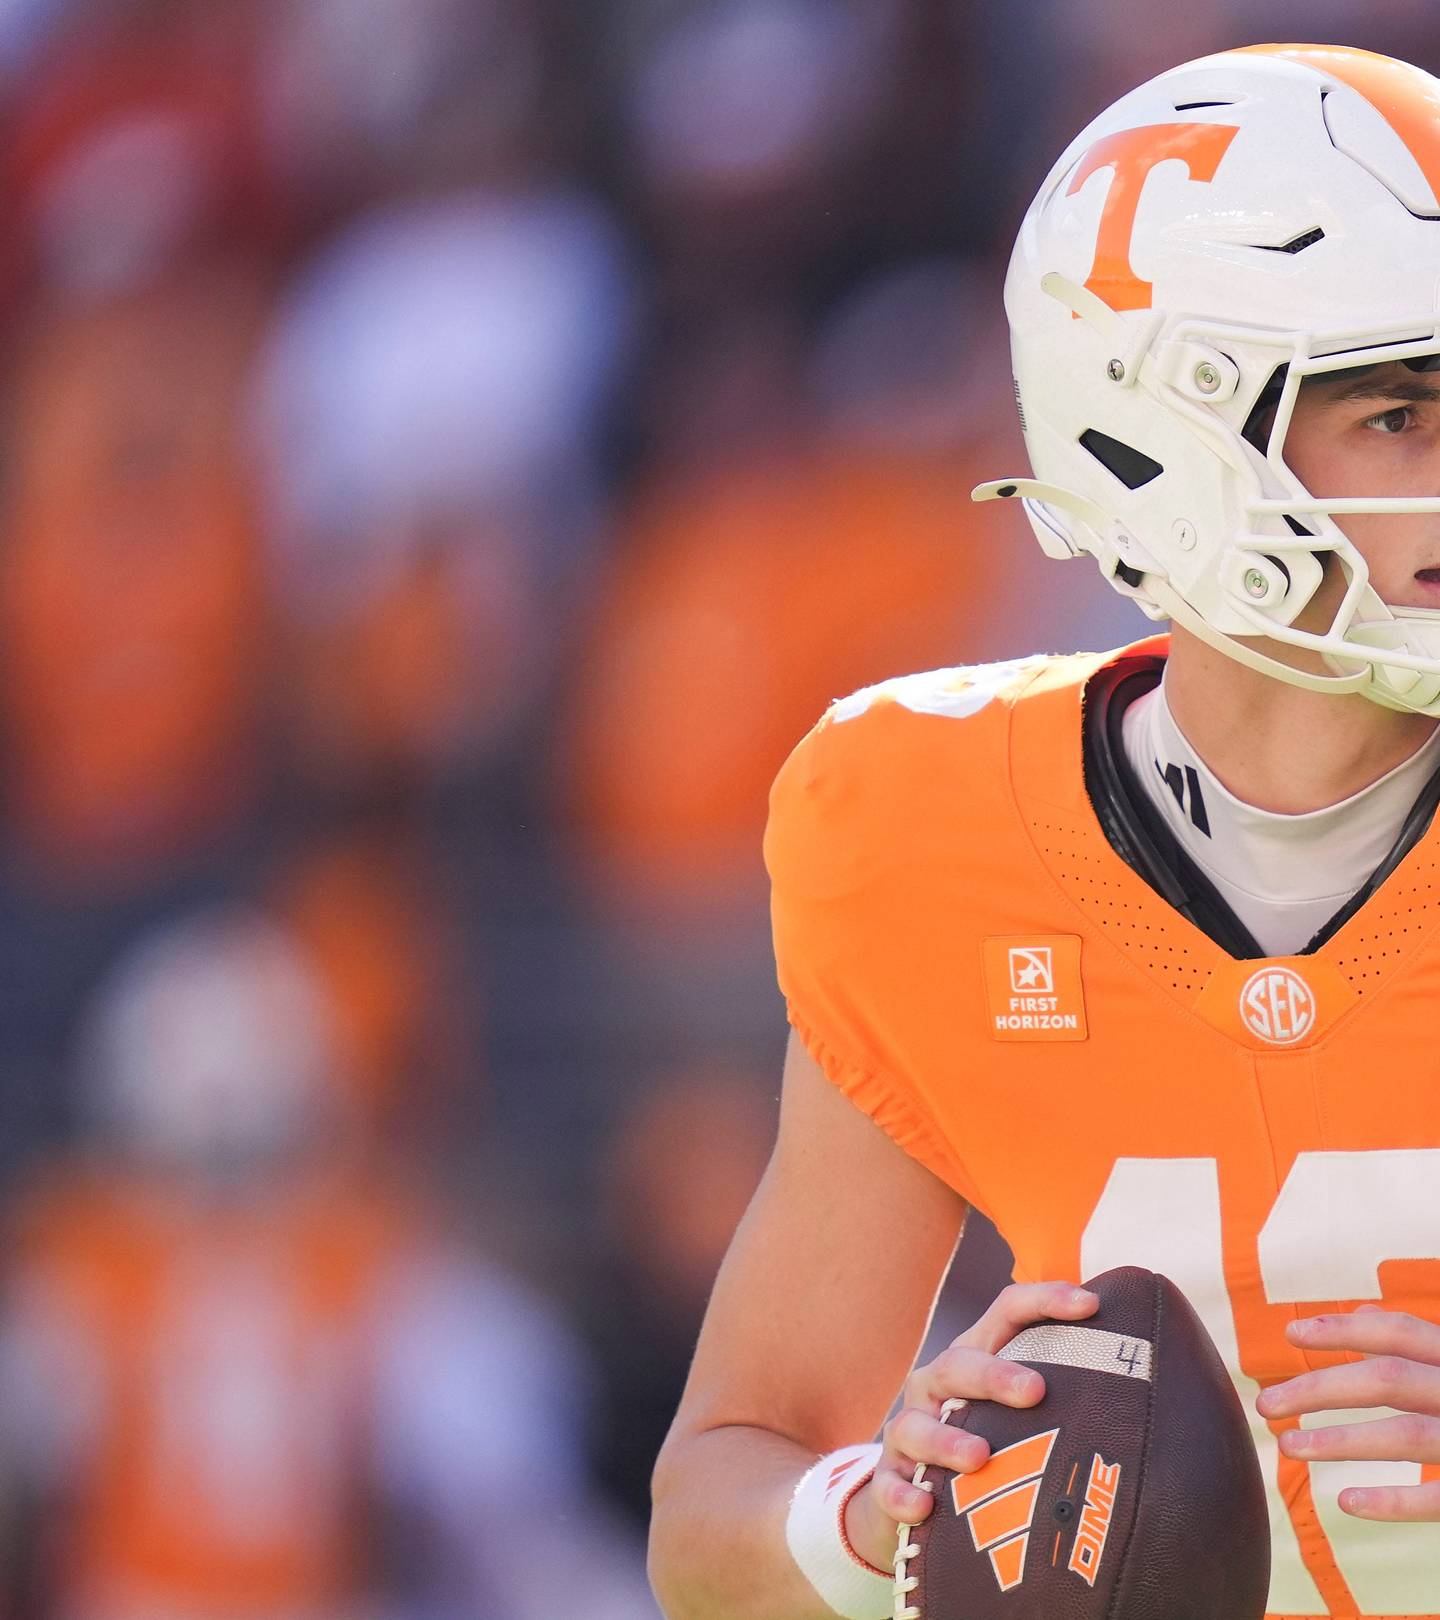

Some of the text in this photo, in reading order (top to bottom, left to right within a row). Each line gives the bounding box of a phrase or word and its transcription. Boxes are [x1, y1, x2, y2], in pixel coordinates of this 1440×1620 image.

[1065, 122, 1240, 320] T
[995, 1014, 1077, 1030] HORIZON
[1009, 997, 1058, 1012] FIRST
[1247, 974, 1308, 1038] SEC
[1115, 1340, 1142, 1376] 4
[1067, 1452, 1122, 1588] DIME
